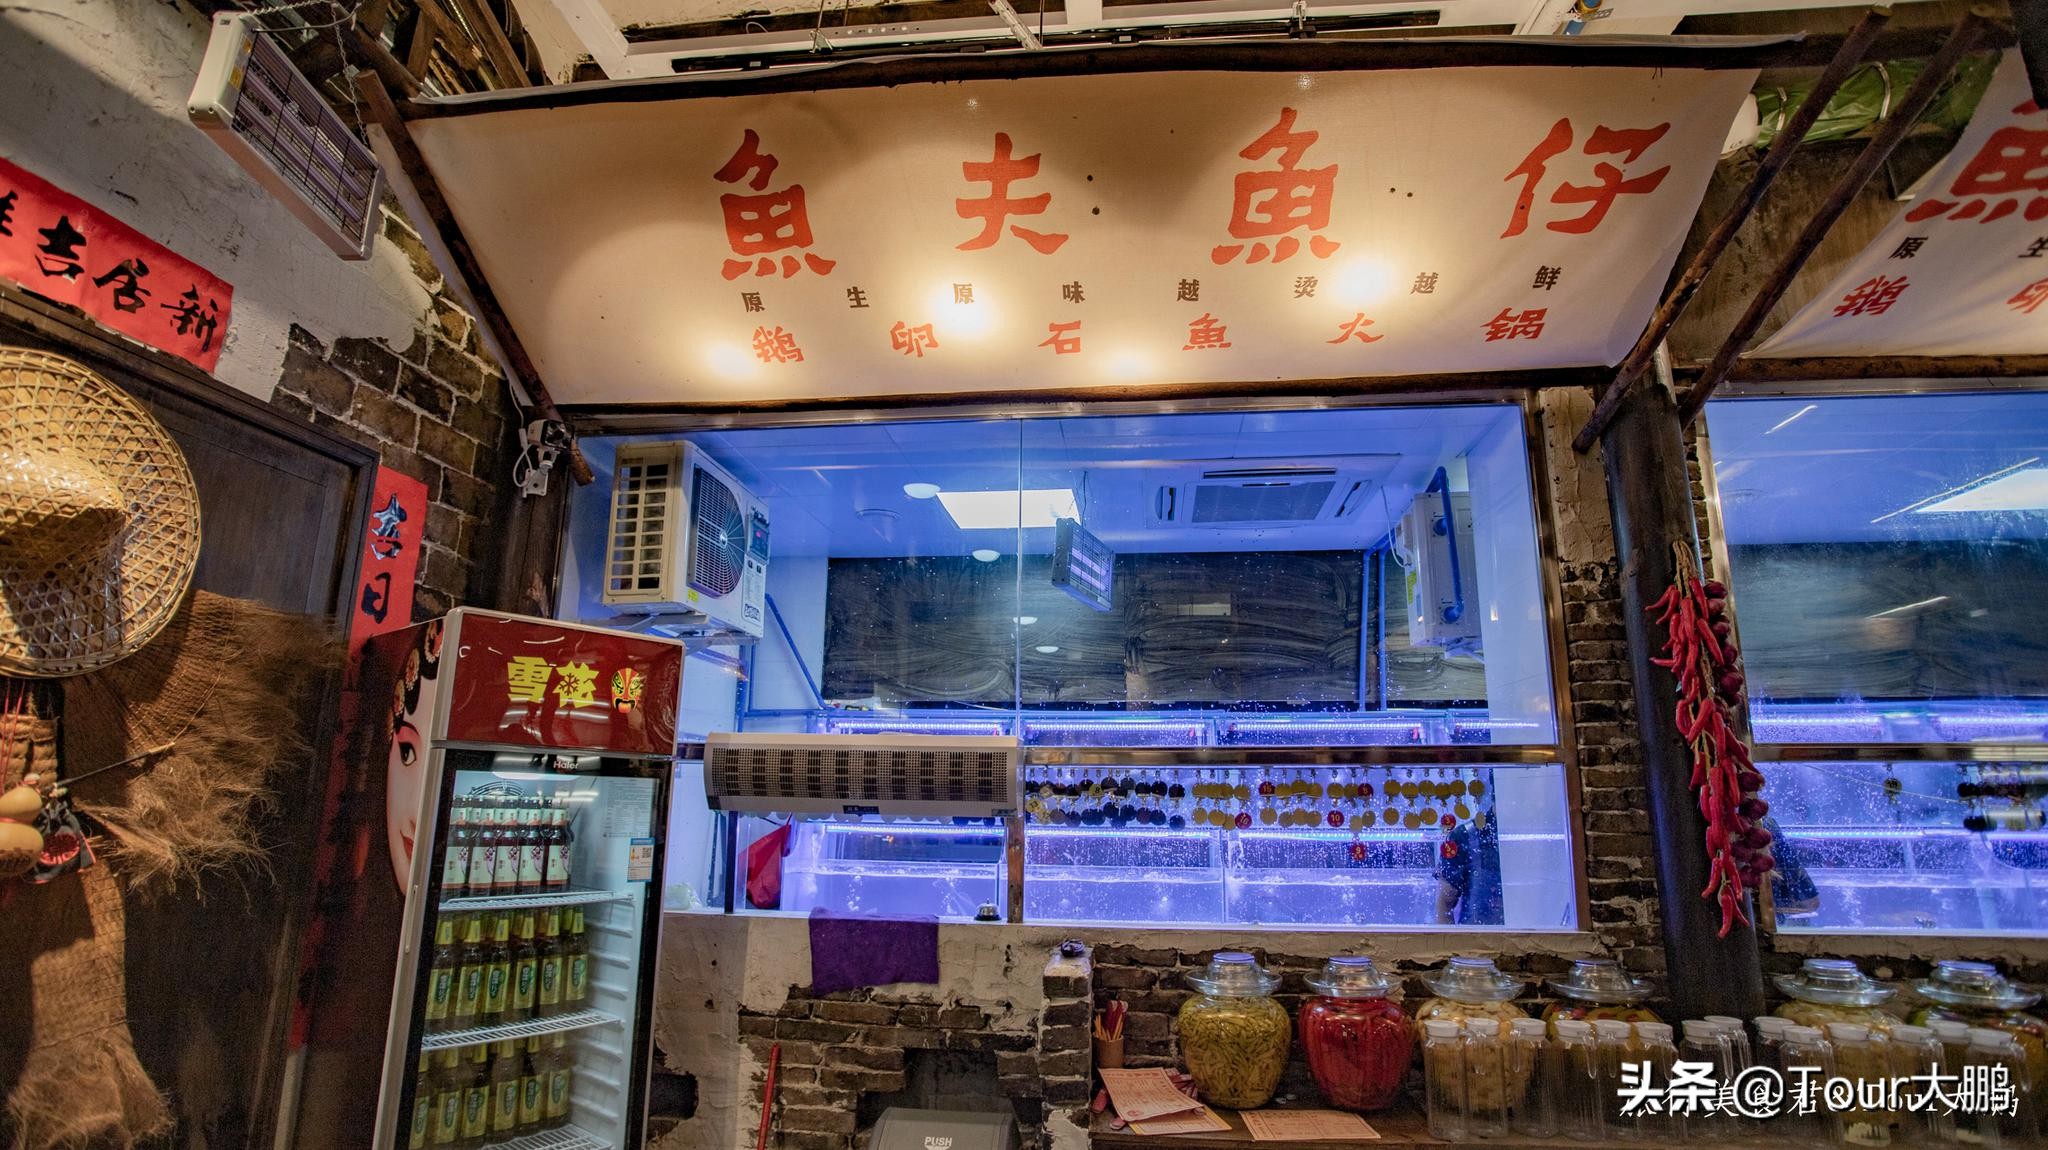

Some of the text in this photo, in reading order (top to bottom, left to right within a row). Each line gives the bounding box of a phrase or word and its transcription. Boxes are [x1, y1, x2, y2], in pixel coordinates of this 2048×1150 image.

[713, 106, 1672, 281] 魚夫魚仔
[740, 264, 1562, 313] 原生原味越烫越鲜
[751, 306, 1548, 363] 鹅卵石魚火锅
[506, 655, 599, 708] 雪花
[553, 760, 579, 769] Haier
[924, 1136, 953, 1147] PUSH
